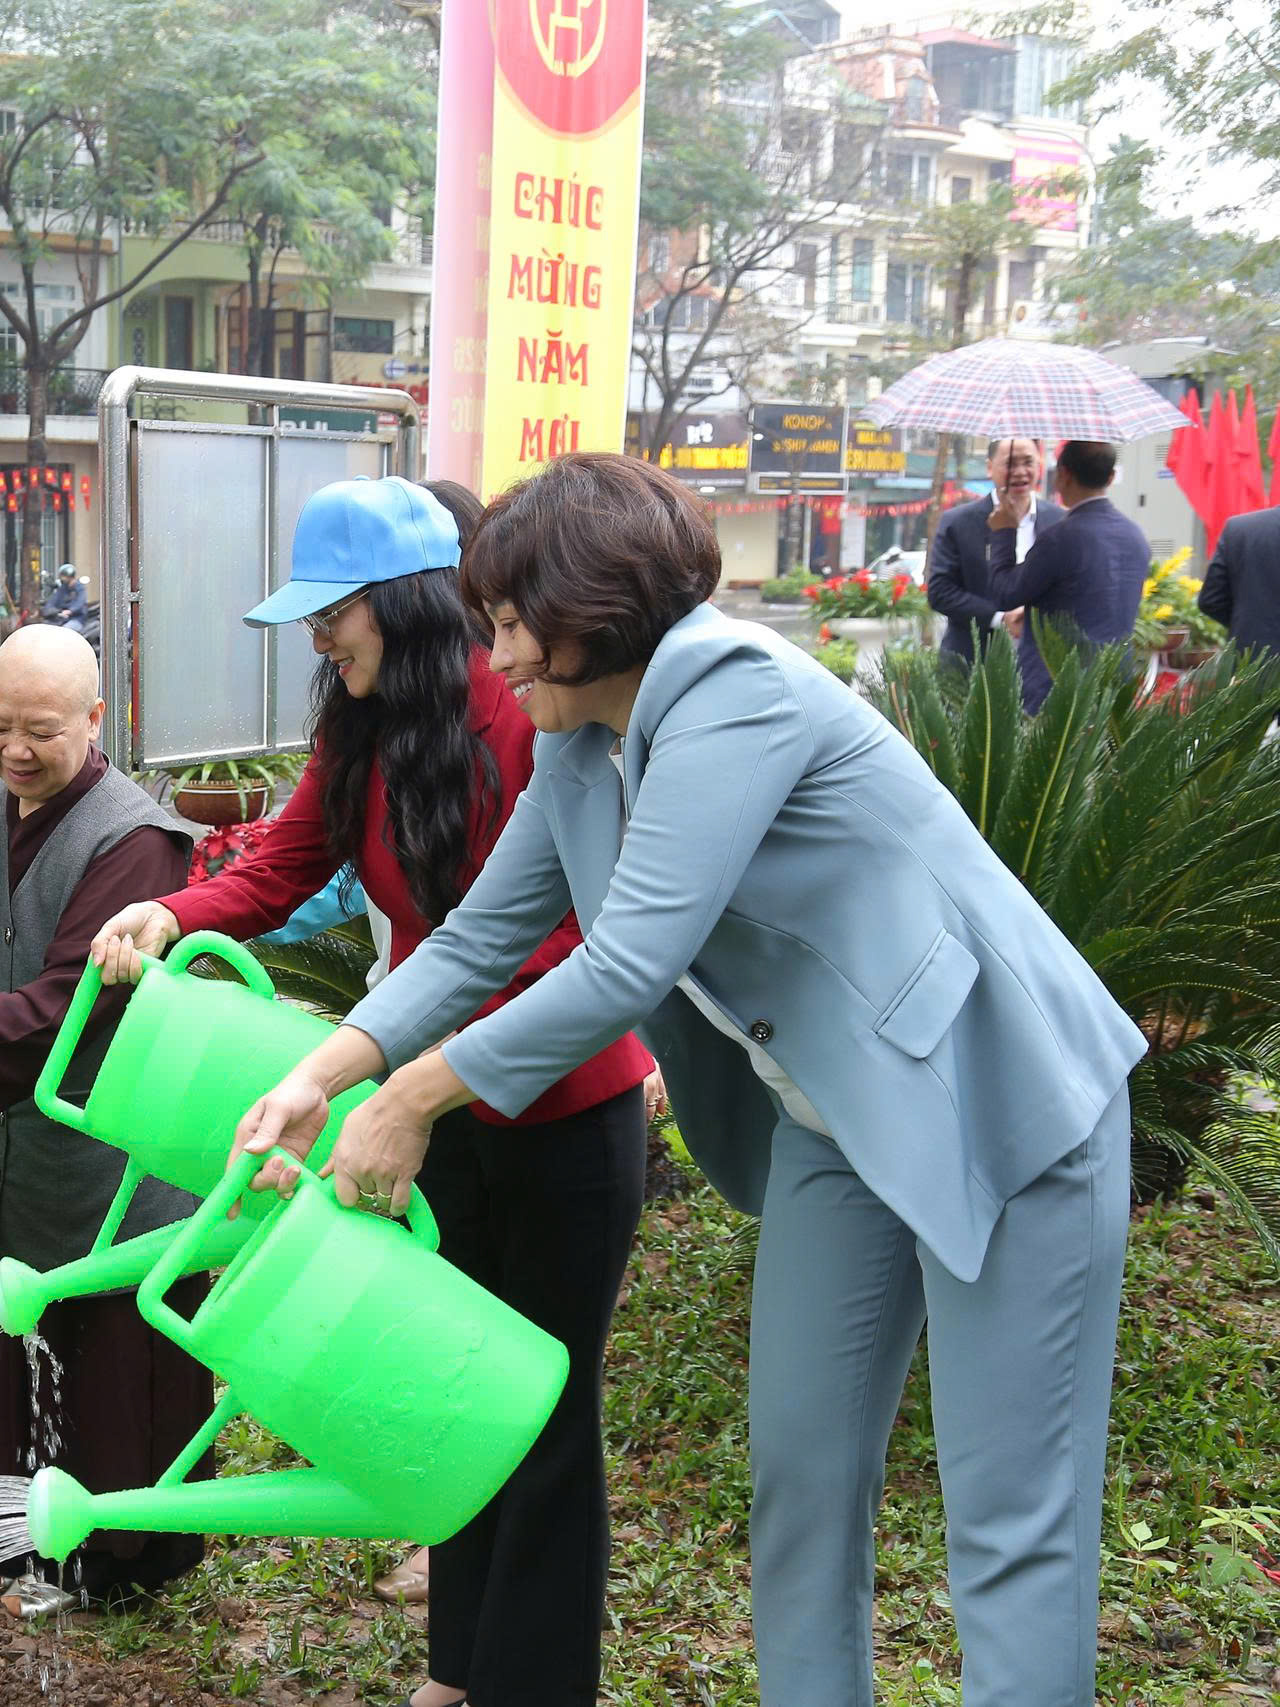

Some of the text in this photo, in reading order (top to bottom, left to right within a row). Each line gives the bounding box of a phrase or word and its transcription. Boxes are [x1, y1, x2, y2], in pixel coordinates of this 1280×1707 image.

[514, 172, 604, 231] CHÚC
[507, 248, 601, 310] MỪNG
[517, 329, 589, 386] NĂM
